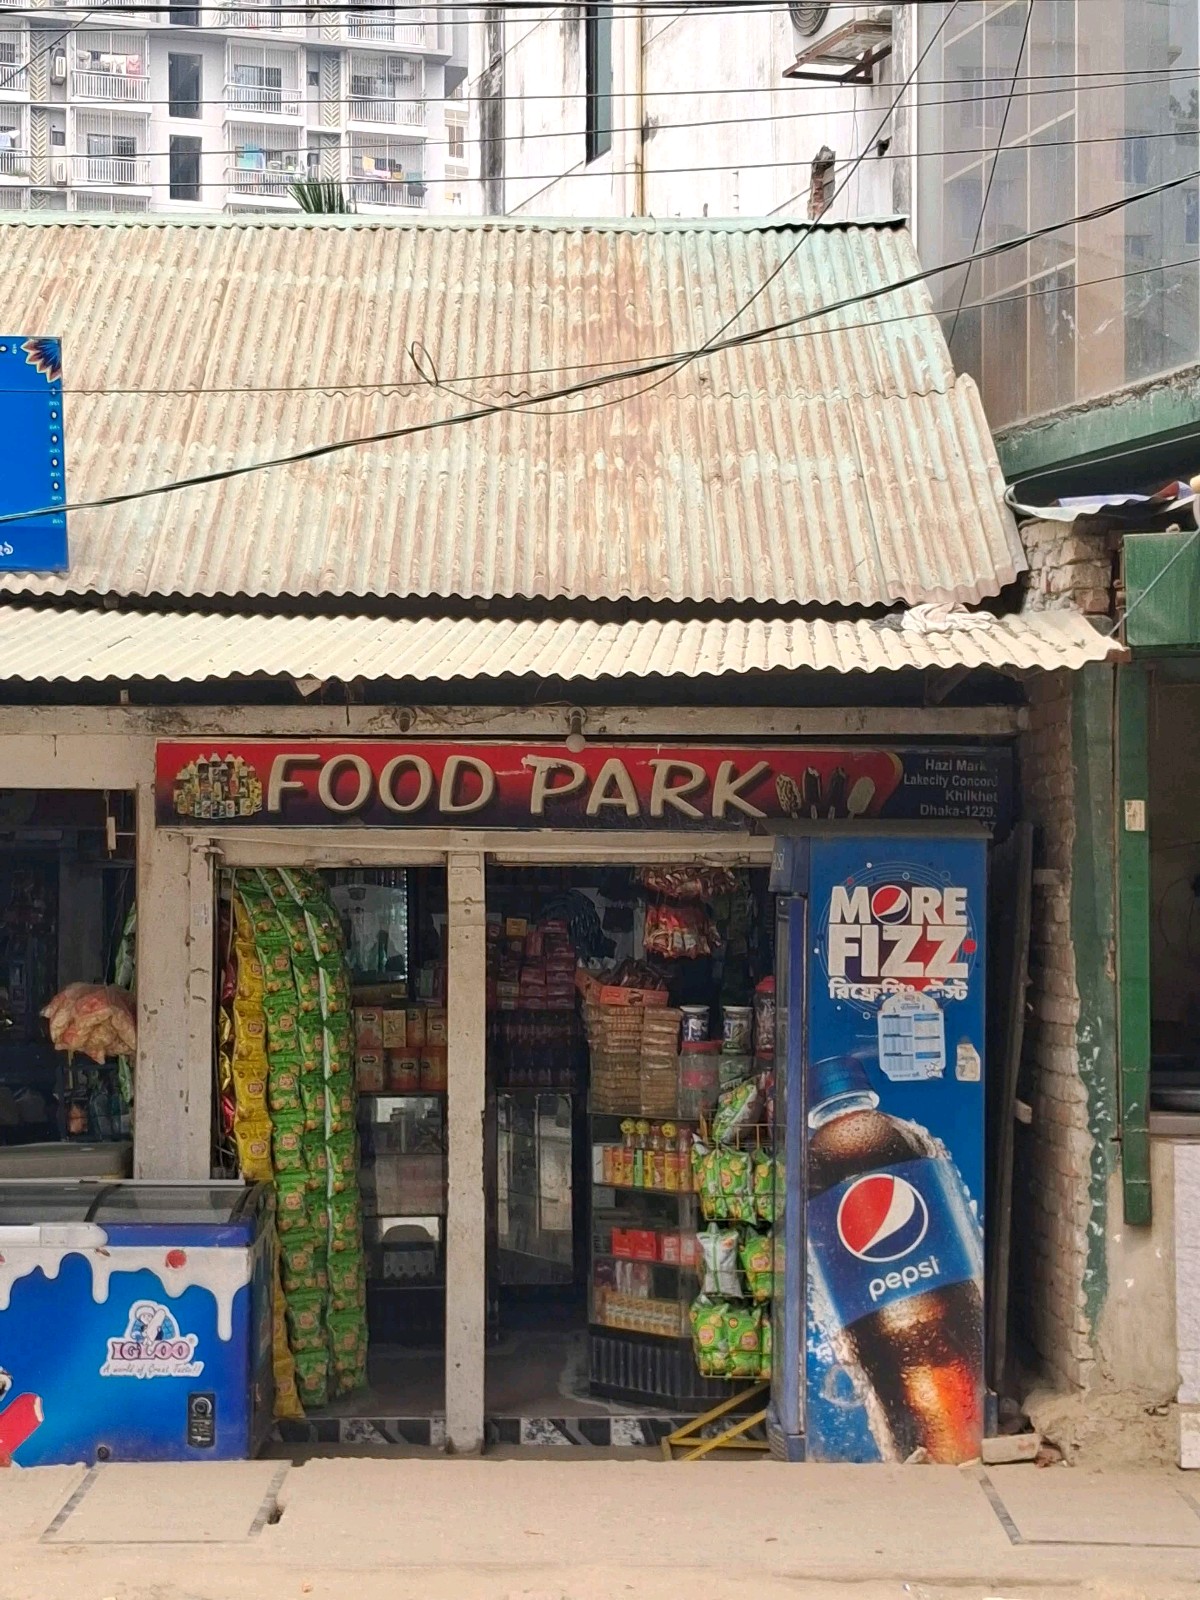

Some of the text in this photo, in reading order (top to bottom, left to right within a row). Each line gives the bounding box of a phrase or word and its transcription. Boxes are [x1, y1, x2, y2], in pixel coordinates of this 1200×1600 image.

[267, 754, 772, 818] FOOD PARK
[904, 773, 949, 788] Lakecity
[945, 790, 998, 802] Khilkhet
[829, 885, 967, 924] MORE
[828, 924, 968, 978] FIZZ
[869, 1255, 940, 1302] pepsi
[111, 1341, 191, 1361] IGLOO
